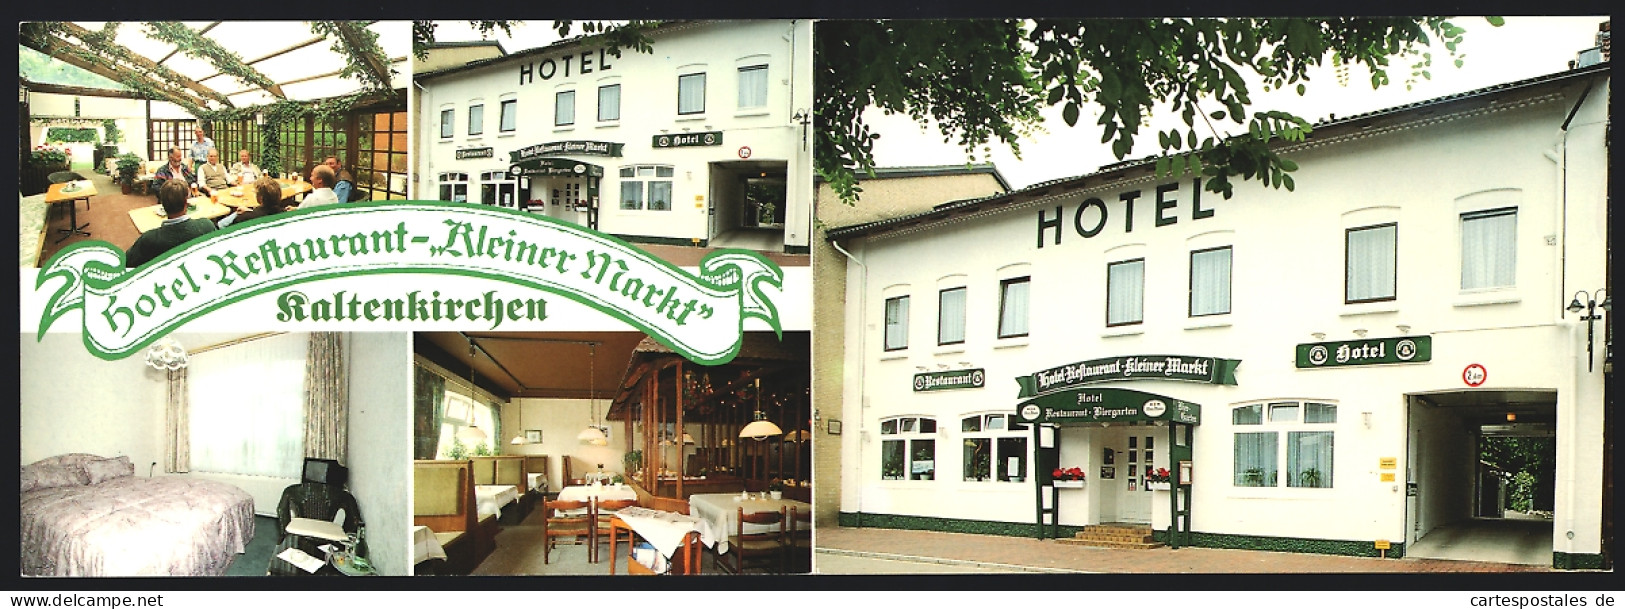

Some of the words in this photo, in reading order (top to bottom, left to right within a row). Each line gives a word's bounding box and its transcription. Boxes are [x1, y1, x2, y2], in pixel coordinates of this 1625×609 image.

[519, 48, 612, 86] HOTEL
[1037, 176, 1215, 249] HOTEL
[276, 289, 549, 331] Kaltenkirchen
[1335, 341, 1386, 363] Hotel
[1165, 356, 1209, 376] Markt
[924, 372, 972, 389] Restaurant
[1077, 392, 1103, 405] Hotel
[1045, 407, 1088, 421] Restaurant
[1093, 406, 1138, 420] Biergarten
